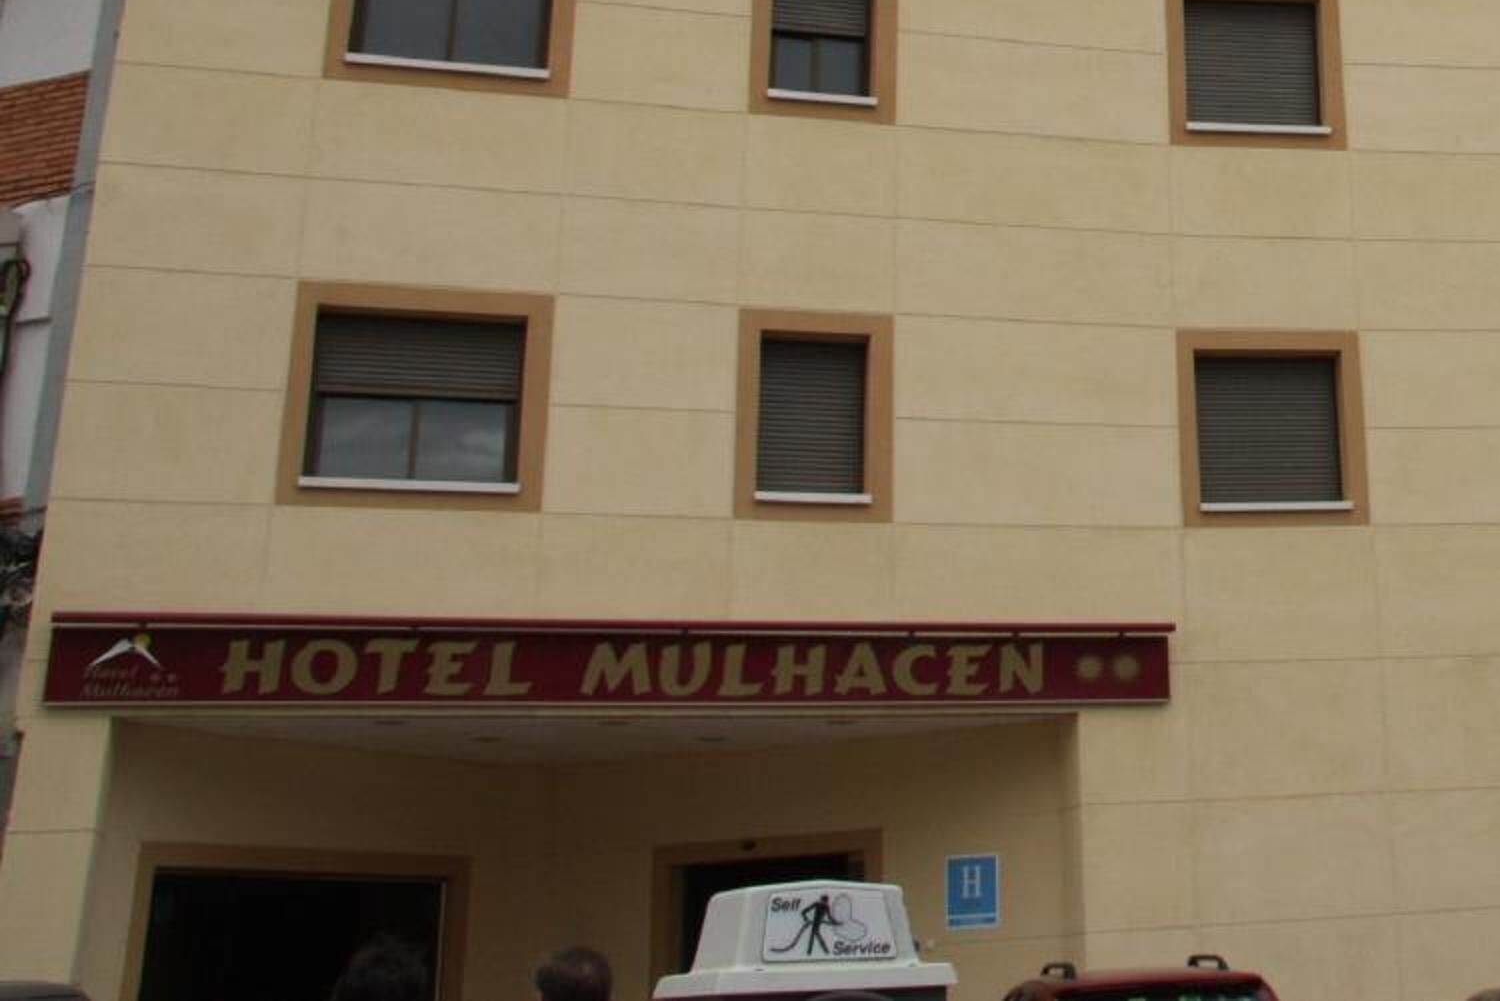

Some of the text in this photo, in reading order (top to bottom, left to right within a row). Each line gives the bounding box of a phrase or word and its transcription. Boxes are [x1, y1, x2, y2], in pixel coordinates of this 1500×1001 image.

[221, 637, 1045, 696] HOTEL MULHACEN
[960, 865, 983, 899] H
[770, 897, 801, 912] Self
[832, 940, 891, 956] Service
